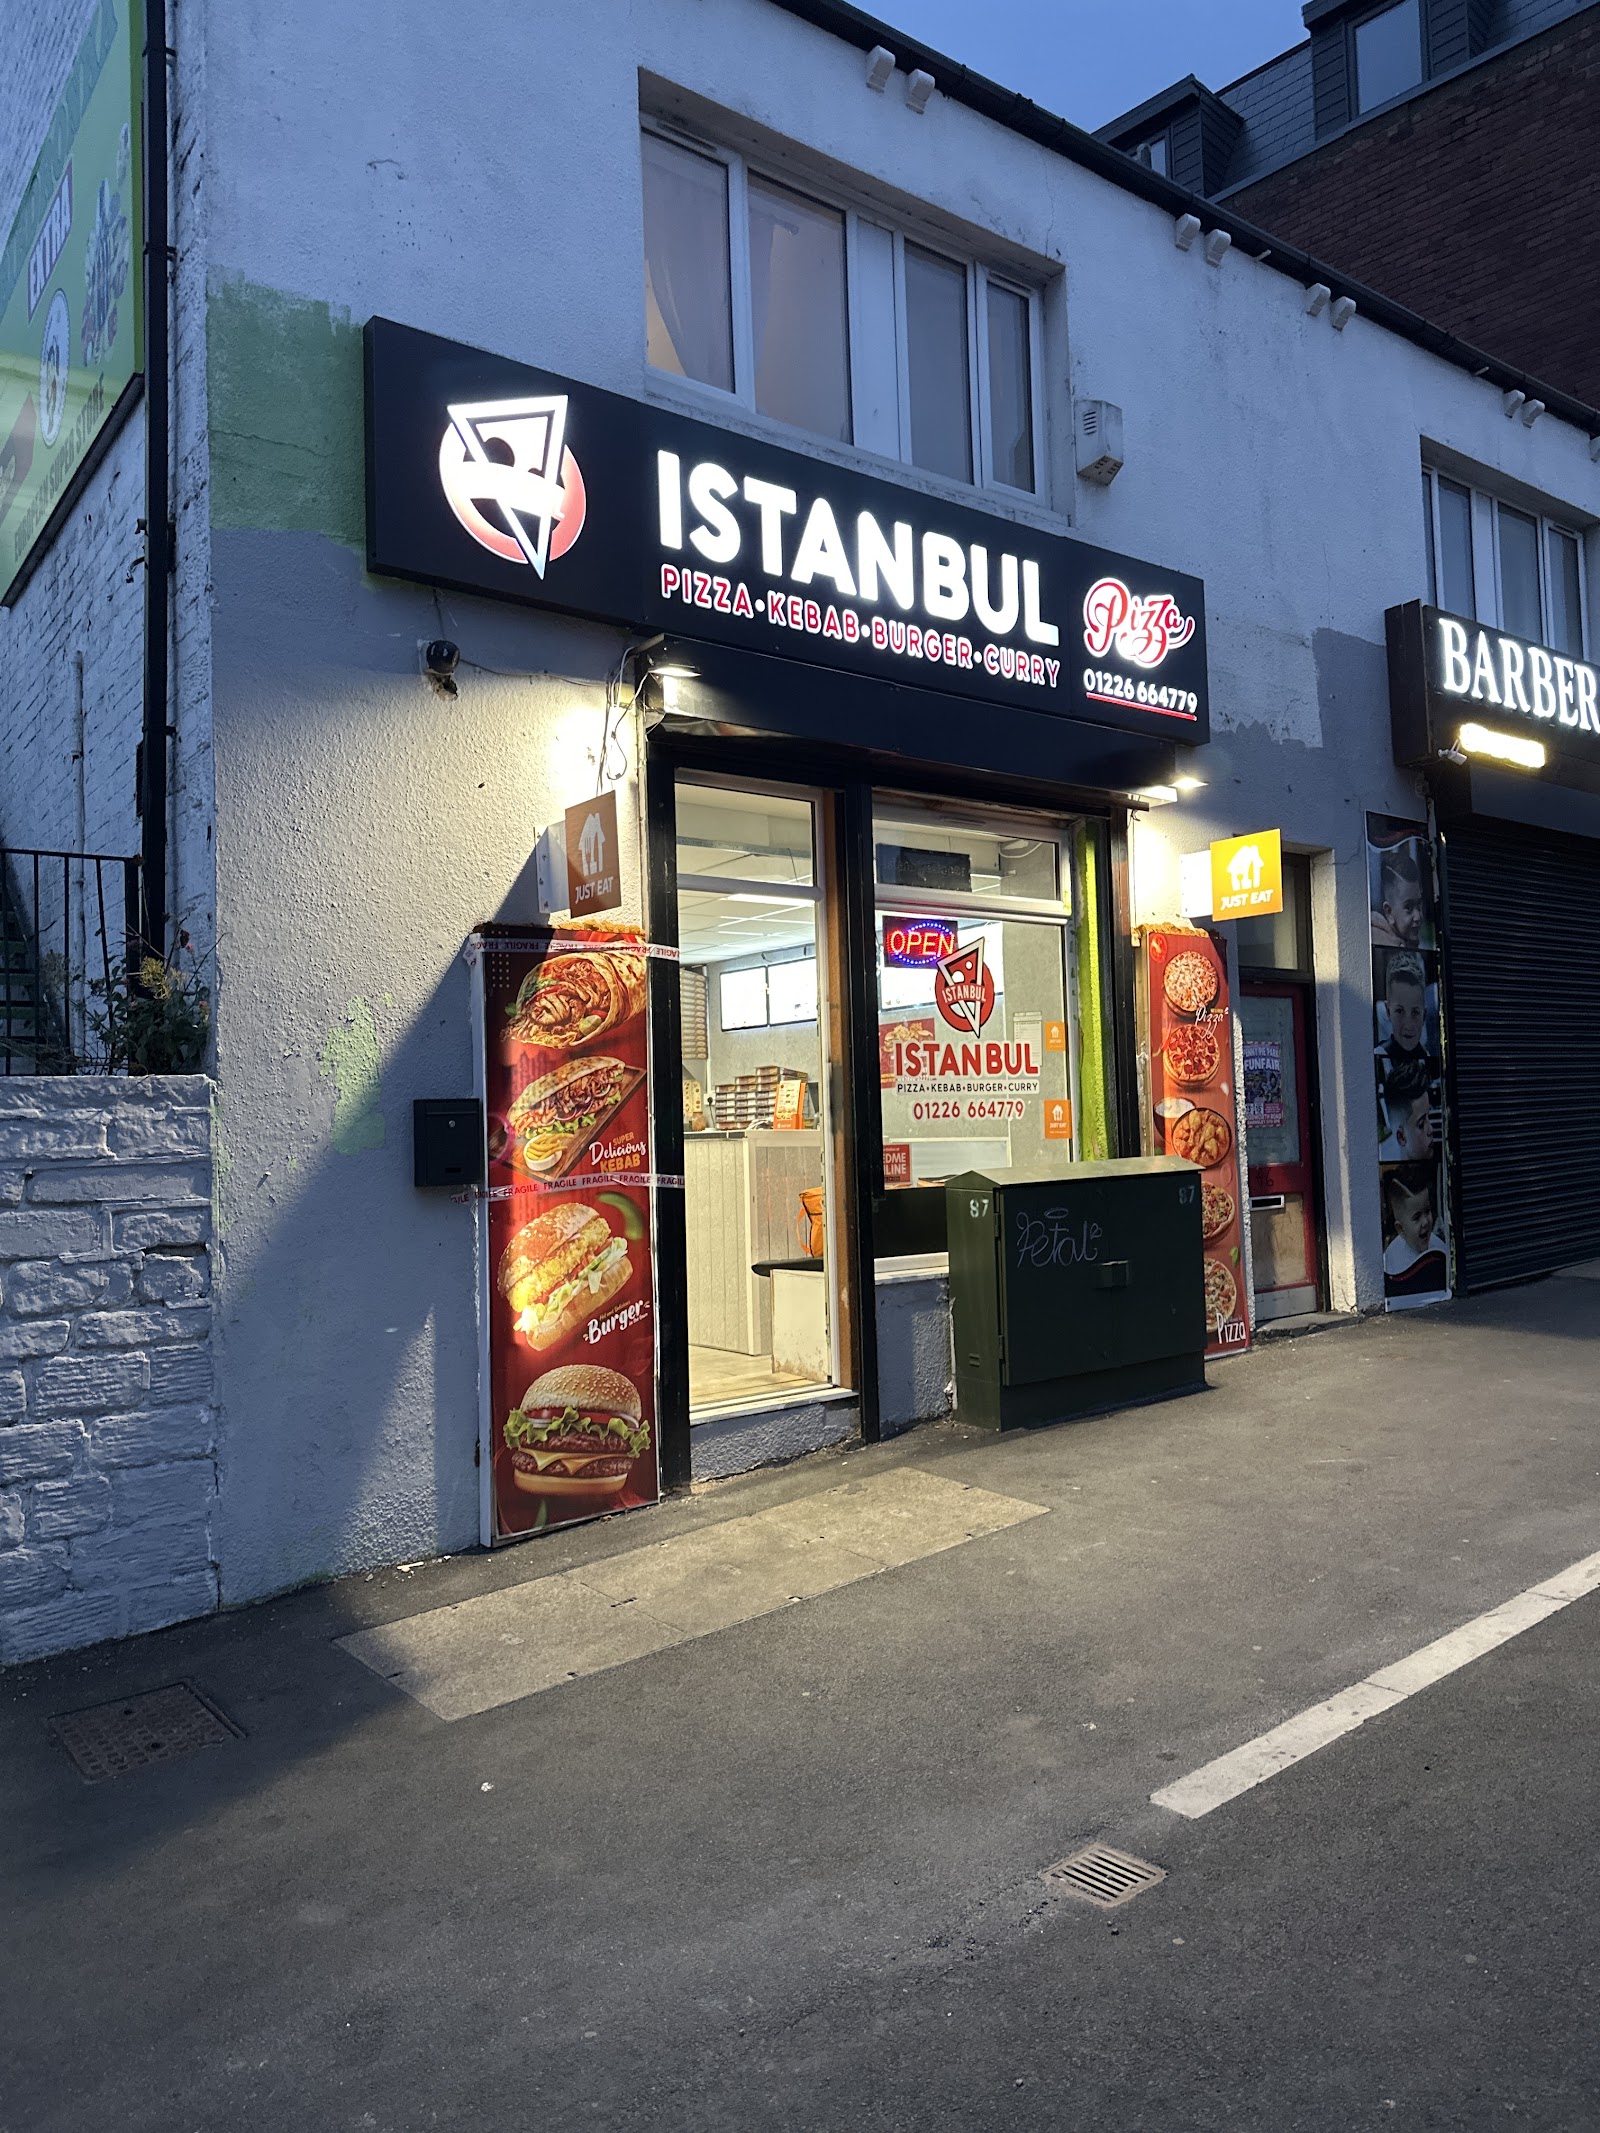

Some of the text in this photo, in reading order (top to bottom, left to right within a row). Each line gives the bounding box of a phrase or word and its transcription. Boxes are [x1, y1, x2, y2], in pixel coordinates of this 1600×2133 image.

[29, 173, 72, 316] EXTRA
[50, 427, 75, 501] SUPER
[76, 370, 104, 454] STORE
[657, 449, 1060, 647] ISTANBUL
[1083, 577, 1196, 670] Pizza
[1438, 617, 1600, 735] BARBER
[1083, 668, 1198, 714] 01226 664779
[575, 876, 614, 905] JUST EAT
[1220, 889, 1274, 911] JUST EAT
[503, 941, 539, 950] FRAGILE
[890, 930, 955, 957] OPEN
[941, 984, 987, 1003] ISTANBUL
[1195, 1004, 1224, 1040] Pizza
[895, 1042, 1039, 1077] ISTANBUL
[1244, 1058, 1281, 1071] FUNFAIR
[913, 1100, 1024, 1120] 01226 664779
[612, 1131, 635, 1146] SUPER
[588, 1140, 647, 1166] Delicious
[599, 1153, 641, 1174] KEBAB
[543, 1178, 577, 1190] FRAGILE
[582, 1174, 614, 1186] FRAGILE
[619, 1175, 651, 1184] FRAGILE
[1178, 1185, 1195, 1204] 87
[969, 1199, 989, 1218] 87
[587, 1299, 644, 1345] Burger
